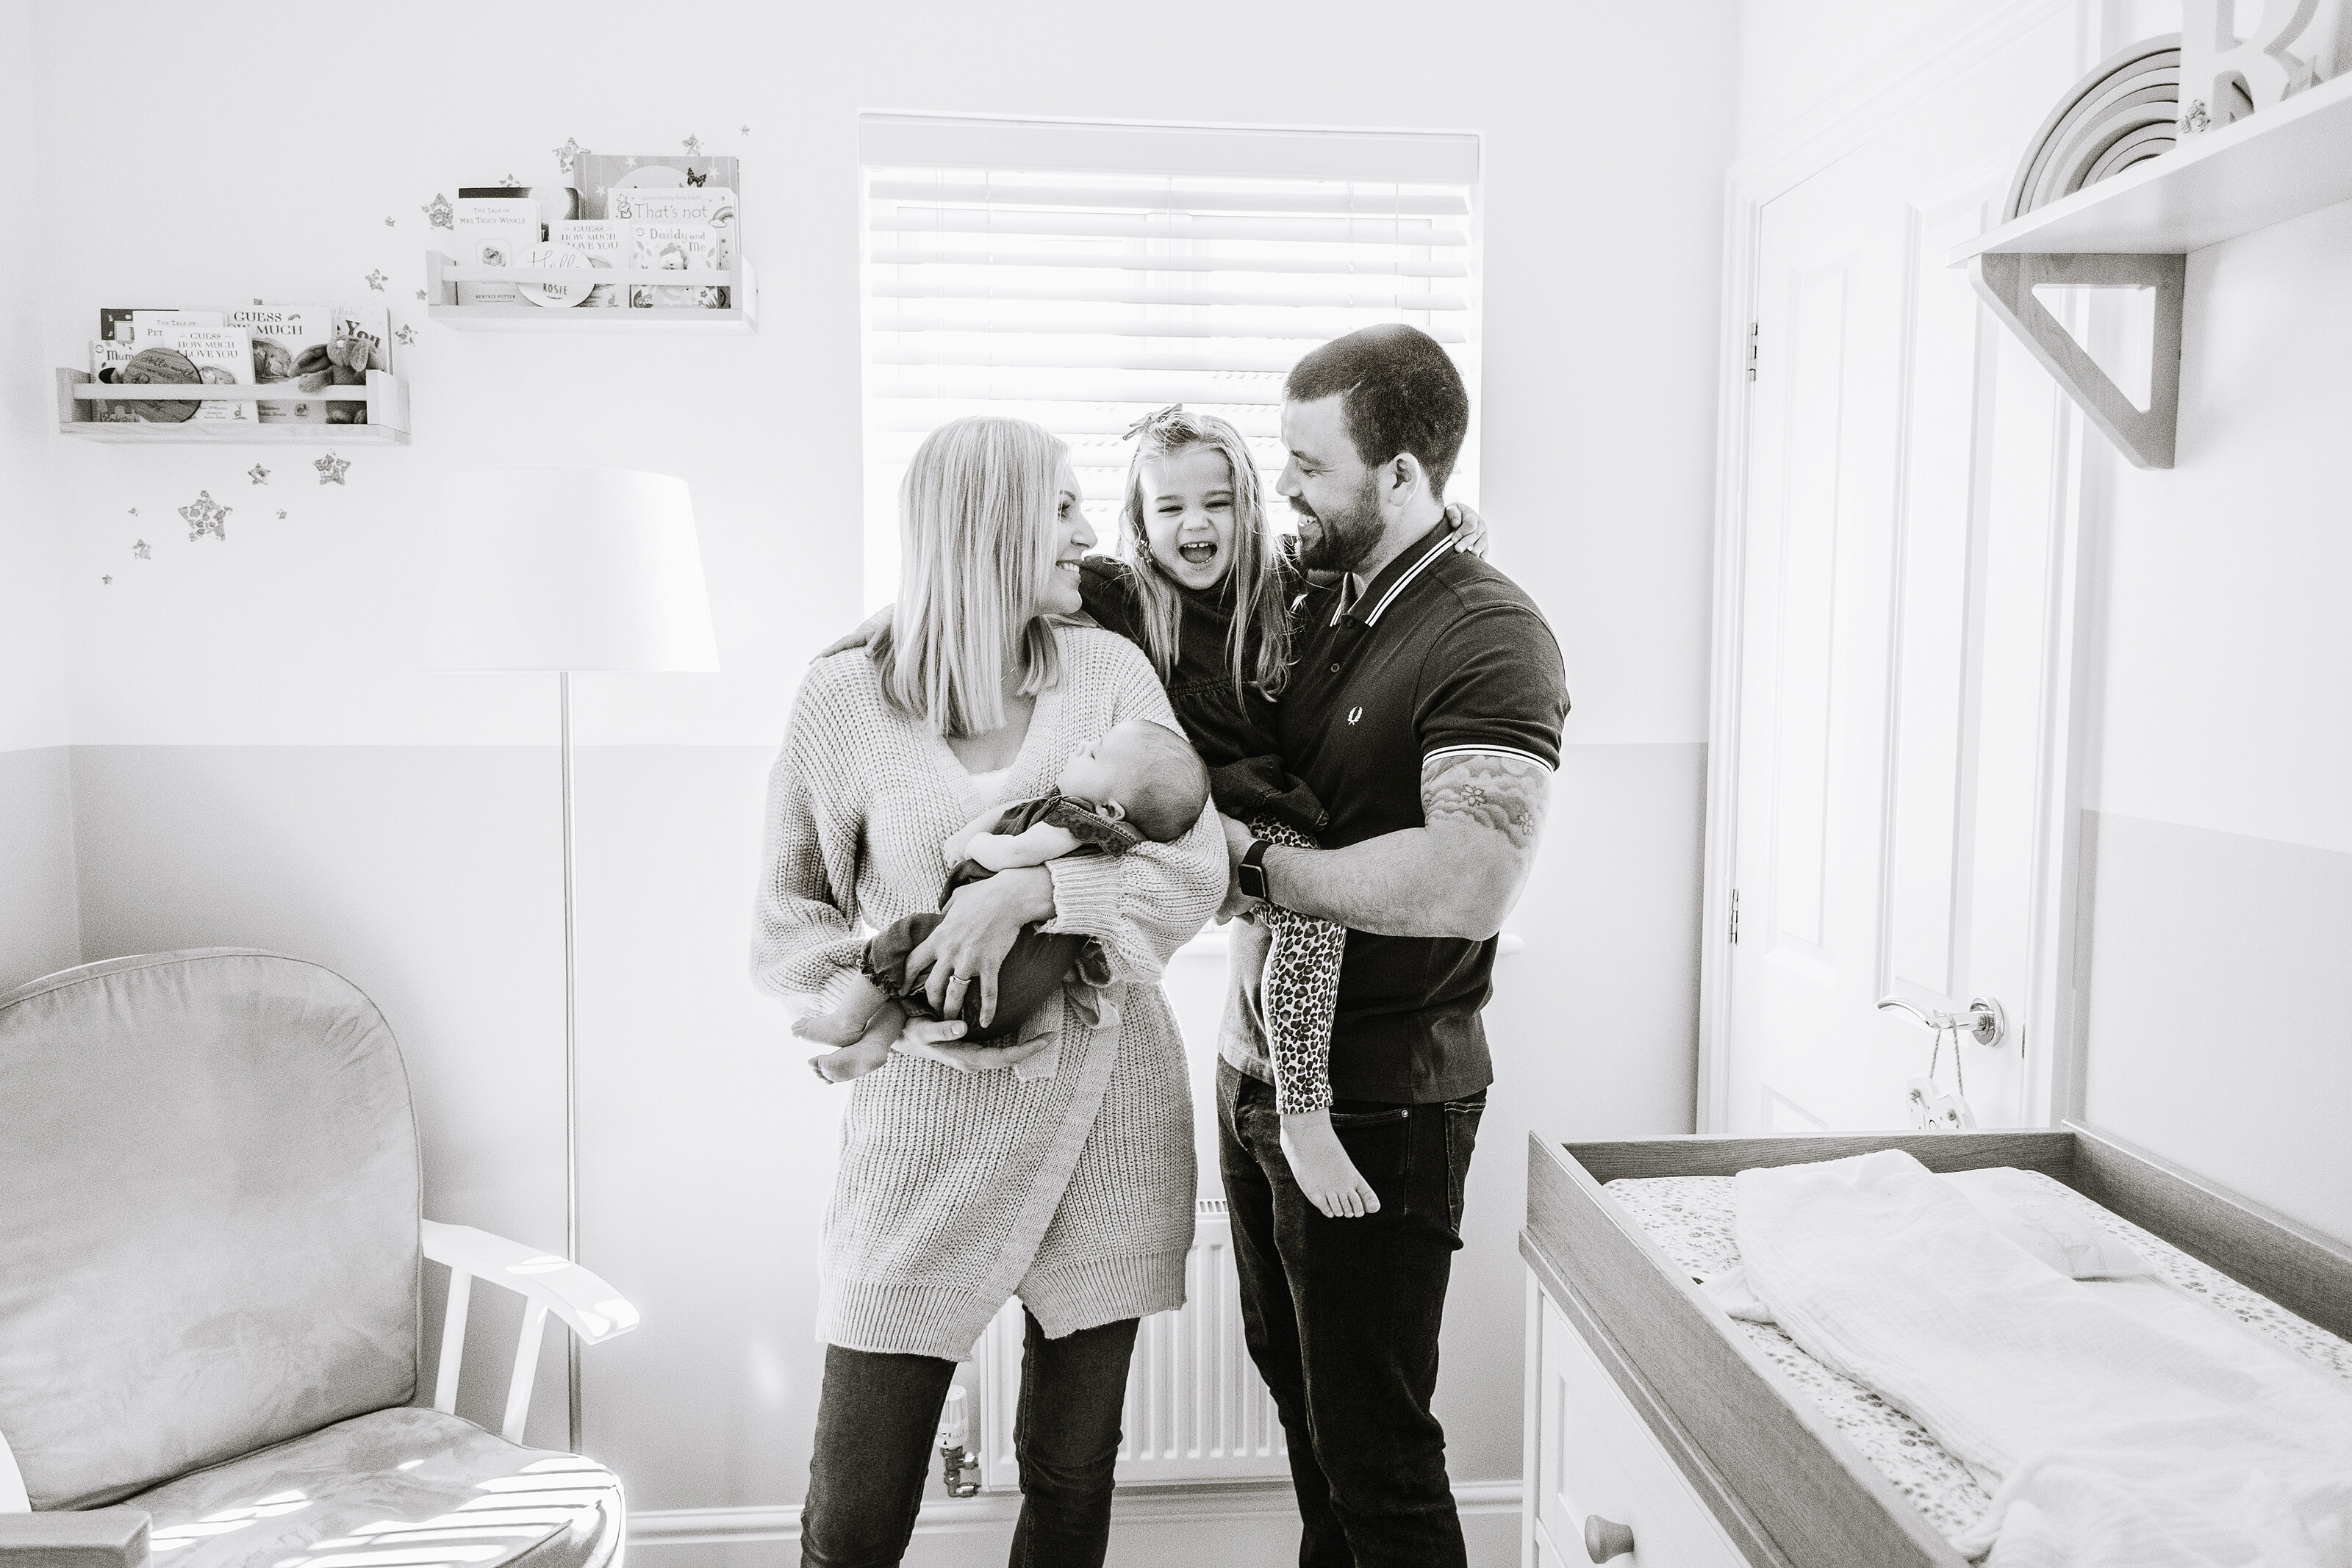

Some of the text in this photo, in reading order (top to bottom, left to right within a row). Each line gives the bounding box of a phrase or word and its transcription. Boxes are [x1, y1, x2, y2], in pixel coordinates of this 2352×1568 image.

[634, 203, 707, 218] That's not
[650, 228, 687, 244] Daddy
[598, 242, 618, 250] YOU
[543, 284, 567, 295] ROSIE
[234, 312, 282, 322] GUESS
[257, 325, 303, 335] MUCH
[184, 350, 214, 358] LOVE
[216, 350, 238, 358] YOU
